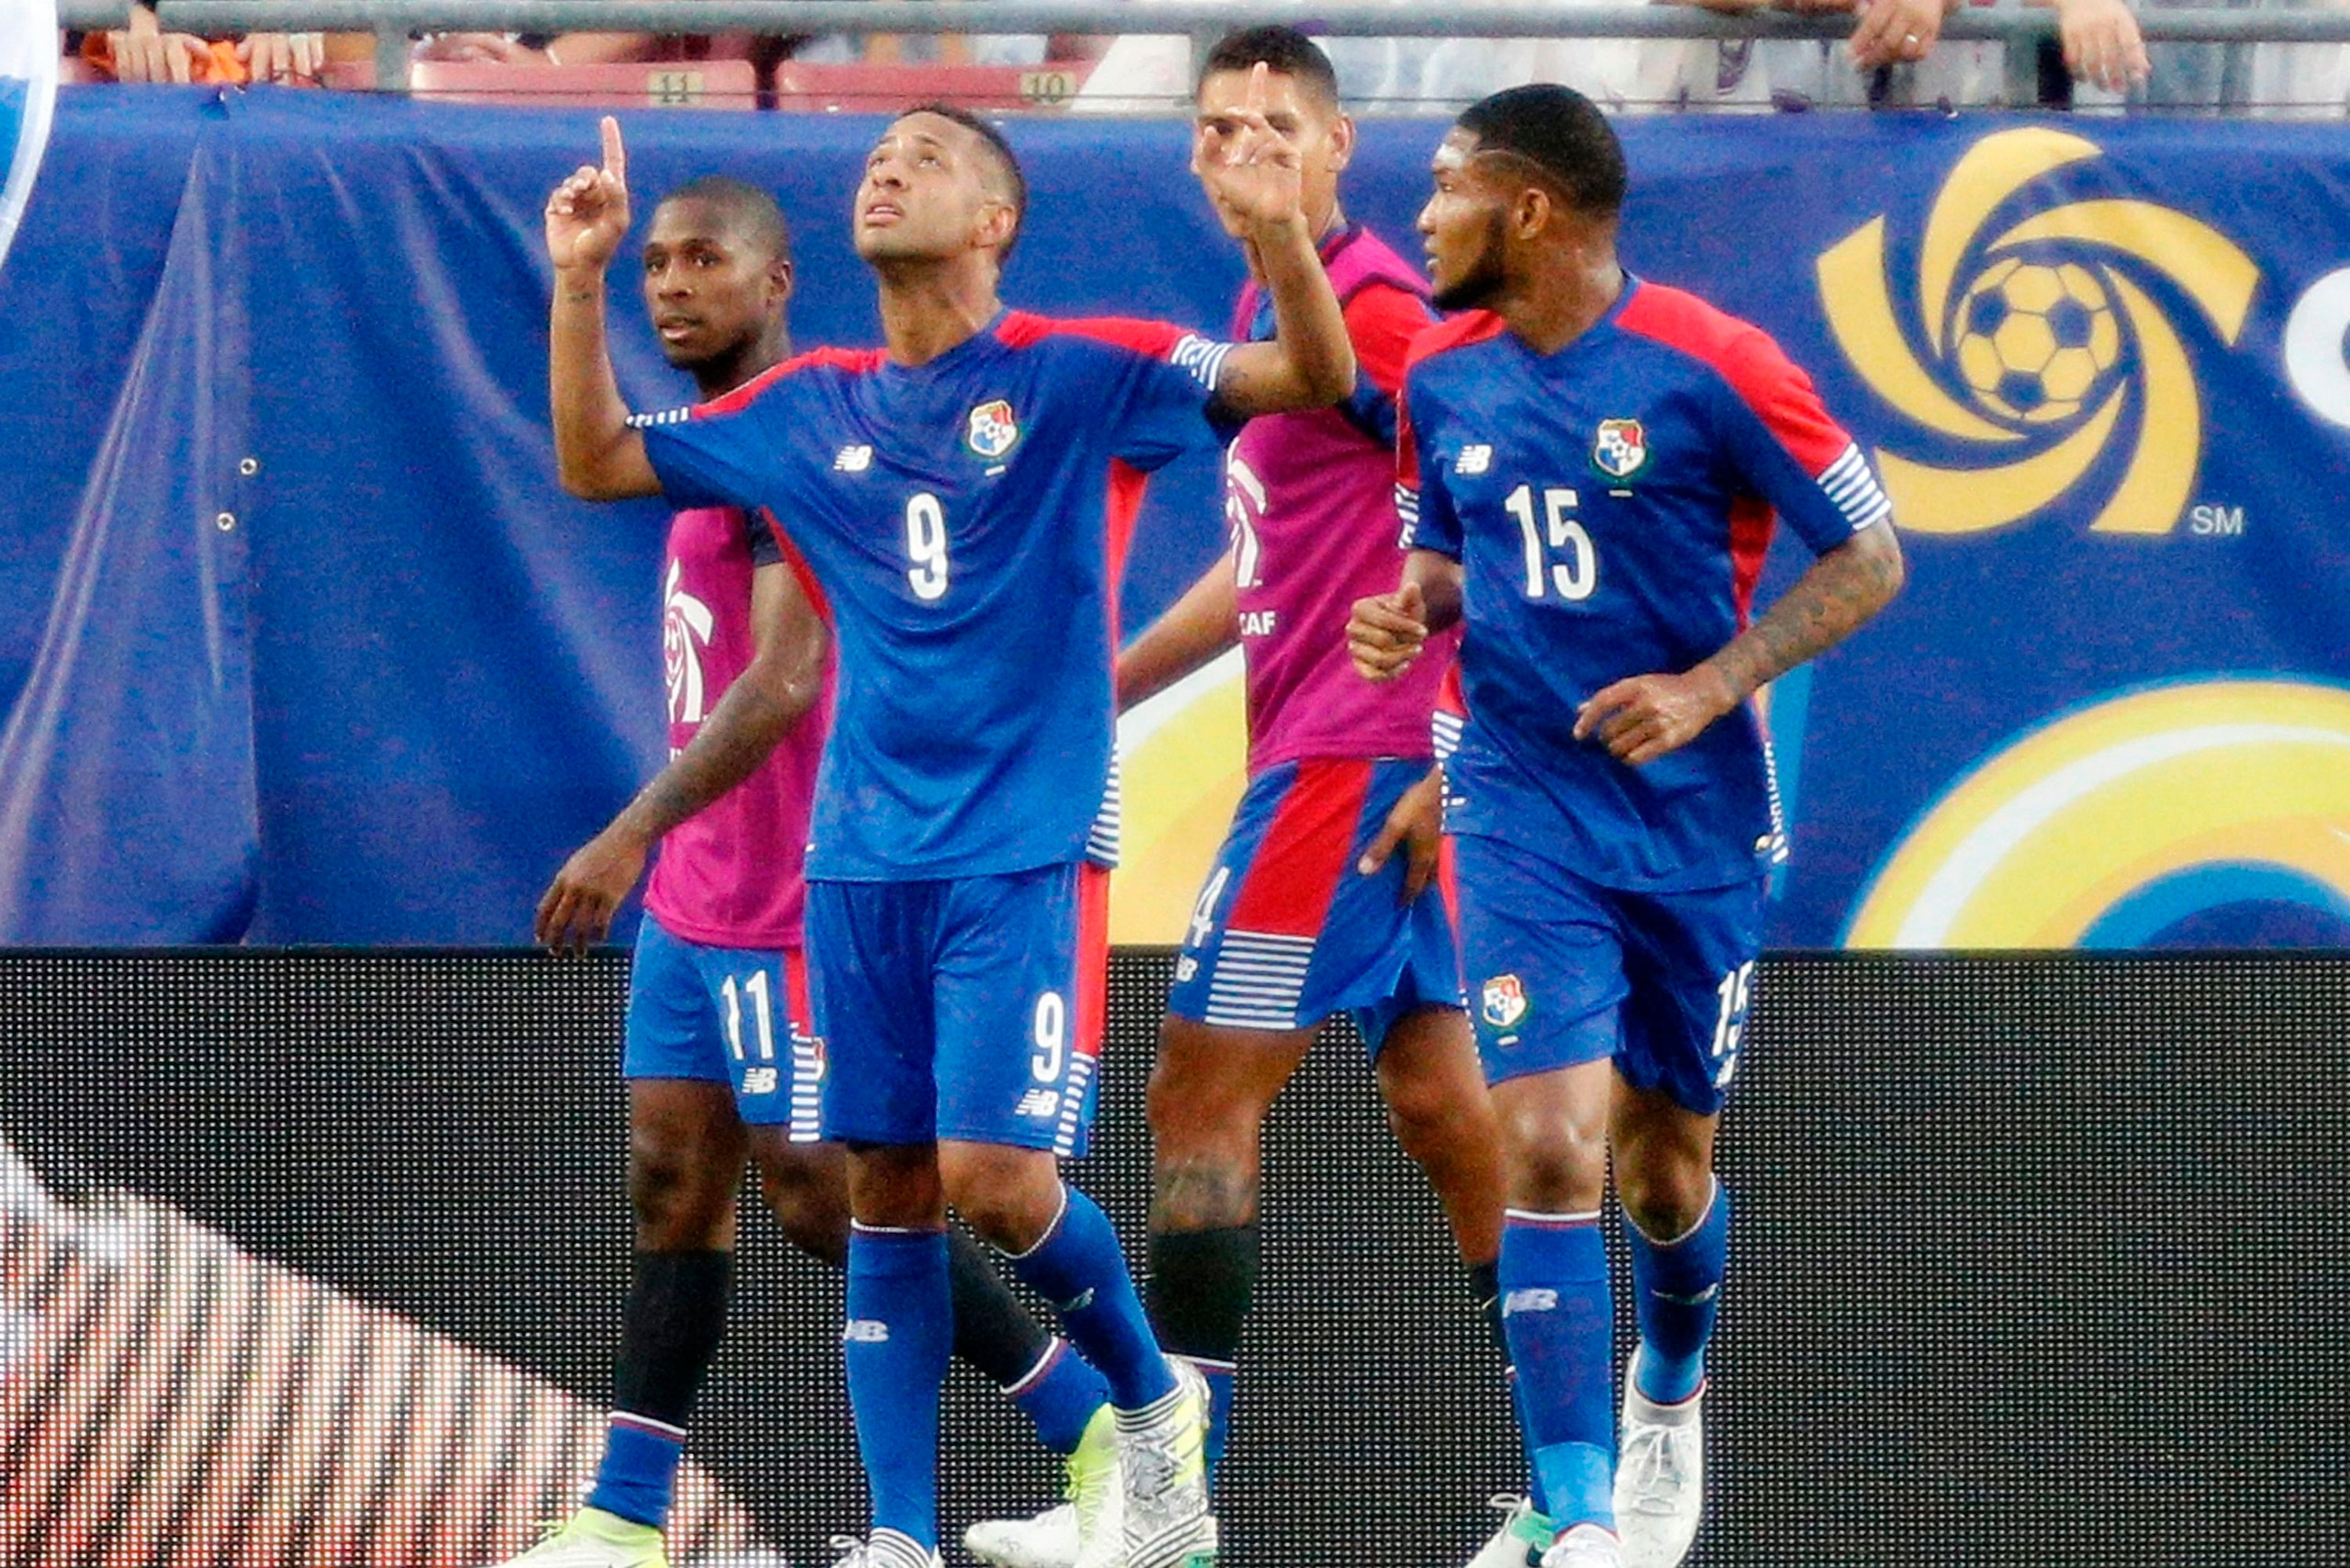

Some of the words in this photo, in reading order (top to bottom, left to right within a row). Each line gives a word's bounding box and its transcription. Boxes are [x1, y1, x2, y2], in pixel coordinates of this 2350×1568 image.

[662, 73, 688, 103] 11
[1030, 74, 1065, 103] 10
[907, 493, 948, 599] 9
[1505, 485, 1596, 600] 15
[2192, 506, 2244, 534] SM
[1192, 866, 1230, 947] 4
[722, 969, 774, 1059] 11
[1032, 991, 1064, 1083] 9
